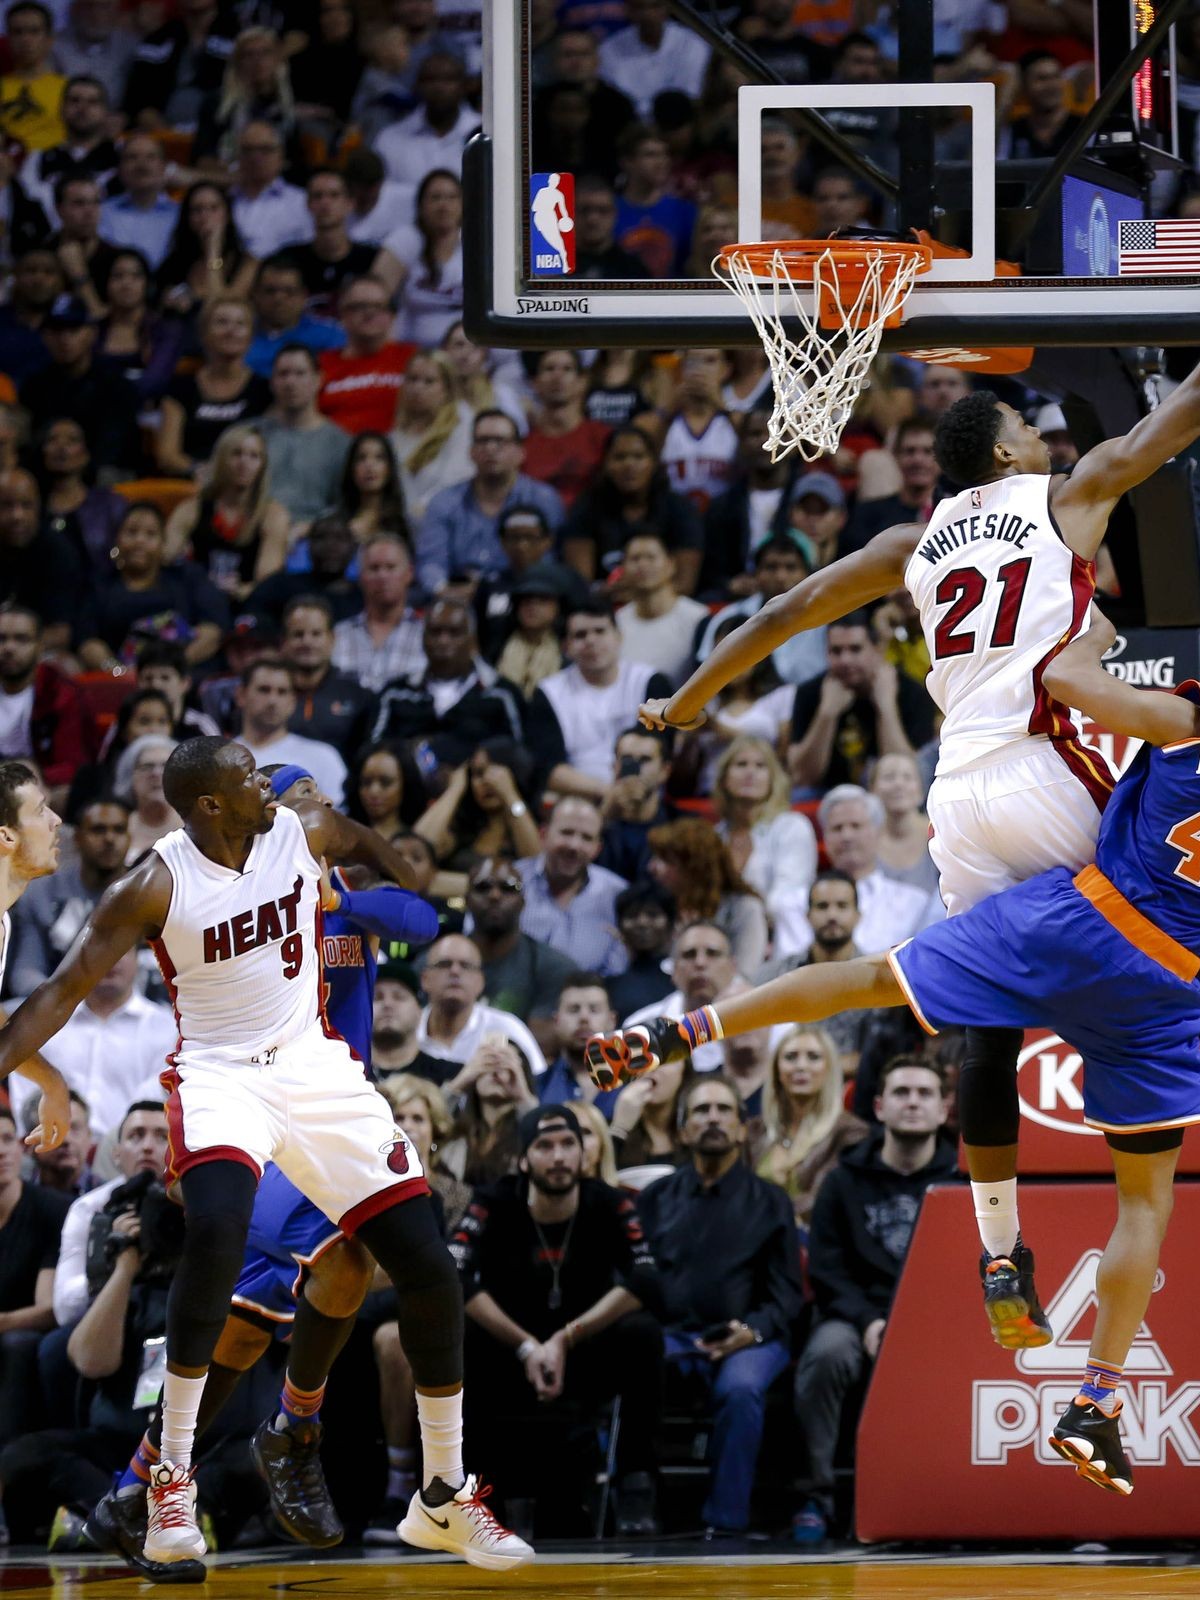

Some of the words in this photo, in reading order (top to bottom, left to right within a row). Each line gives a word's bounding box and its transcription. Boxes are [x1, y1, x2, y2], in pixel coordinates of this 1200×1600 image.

[536, 254, 562, 269] NBA
[516, 298, 591, 315] SPALDING
[918, 513, 1038, 565] WHITESIDE
[934, 556, 1033, 661] 21
[1101, 656, 1176, 688] DING
[203, 875, 303, 963] HEAT
[281, 932, 304, 981] 9
